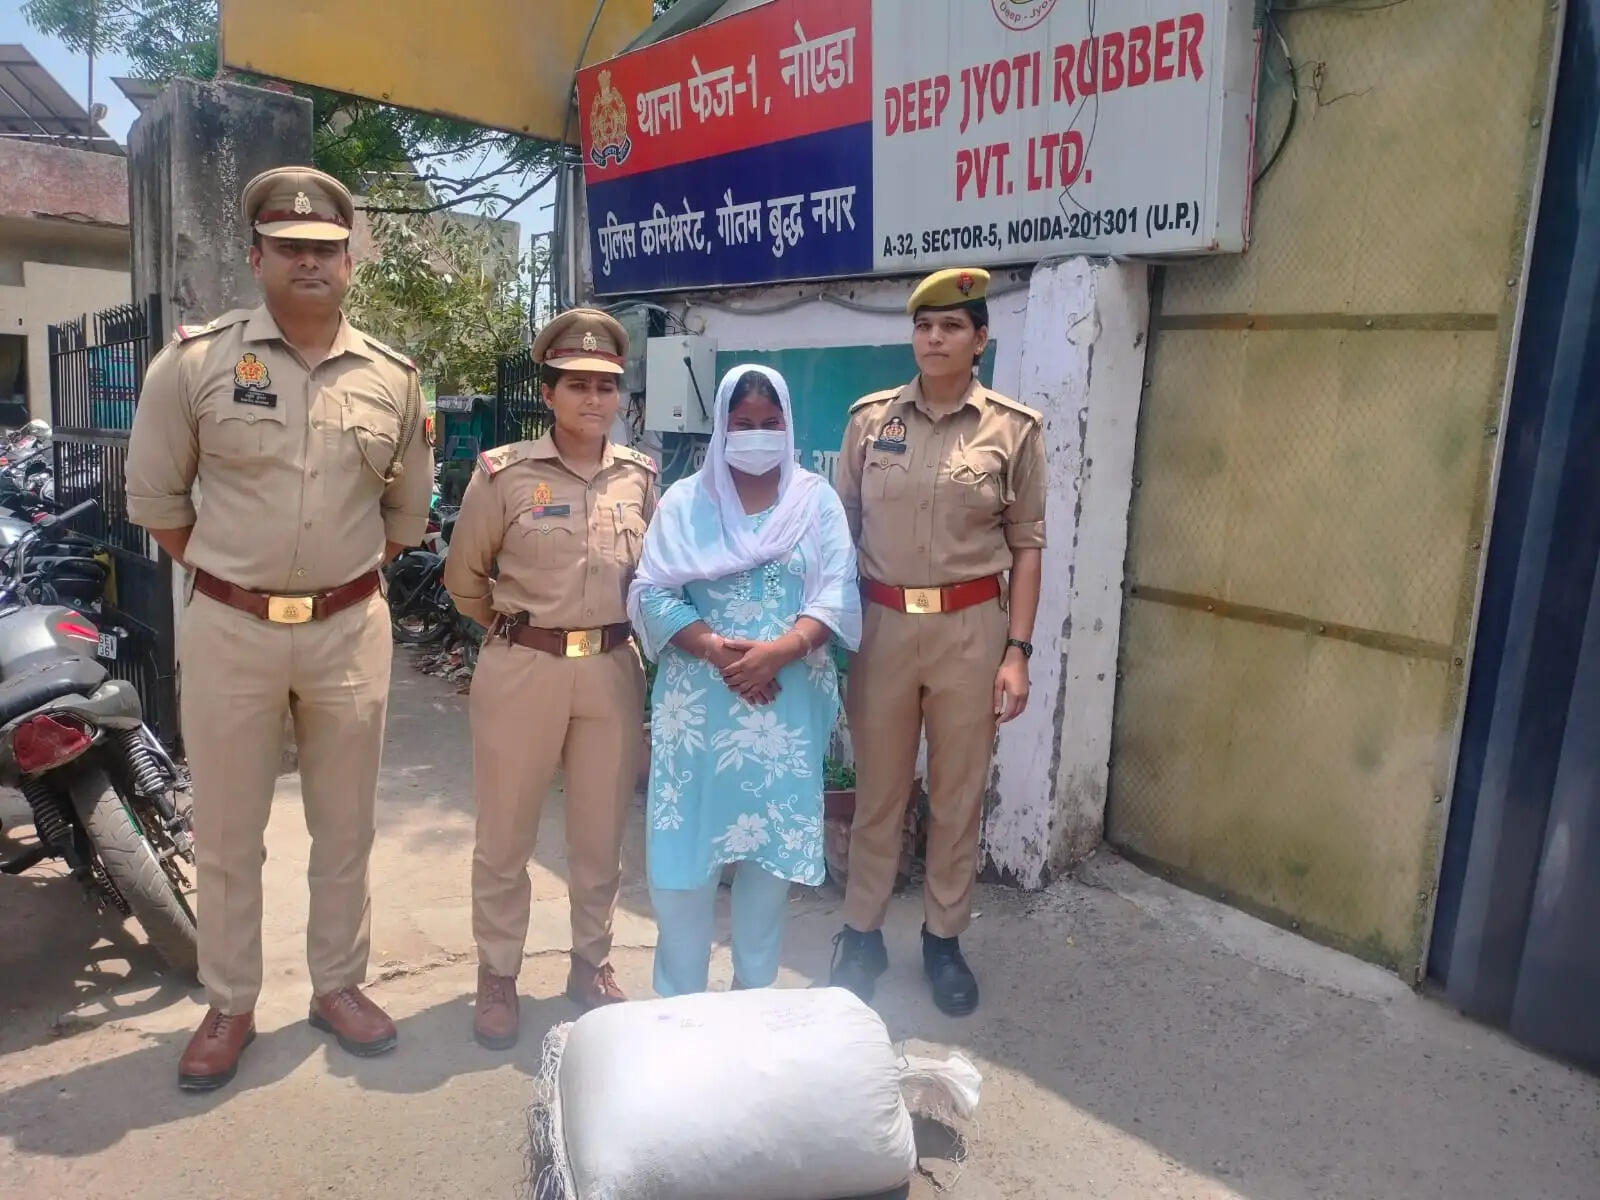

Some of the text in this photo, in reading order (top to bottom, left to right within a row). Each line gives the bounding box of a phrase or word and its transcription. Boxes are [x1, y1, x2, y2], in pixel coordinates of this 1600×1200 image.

[1029, 0, 1052, 18] Jyo
[636, 20, 856, 136] थाना फेज-1, नोएडा
[884, 12, 1205, 137] DEEP JYOTI RUBBER
[956, 130, 1093, 202] PVT. LTD.
[598, 210, 637, 276] पुलिस
[716, 187, 762, 246] गौतम
[767, 194, 805, 258] बुद्ध
[810, 185, 856, 234] नगर
[883, 200, 1200, 259] A-32, SECTOR-5, NOIDA-201301 (U.P.)
